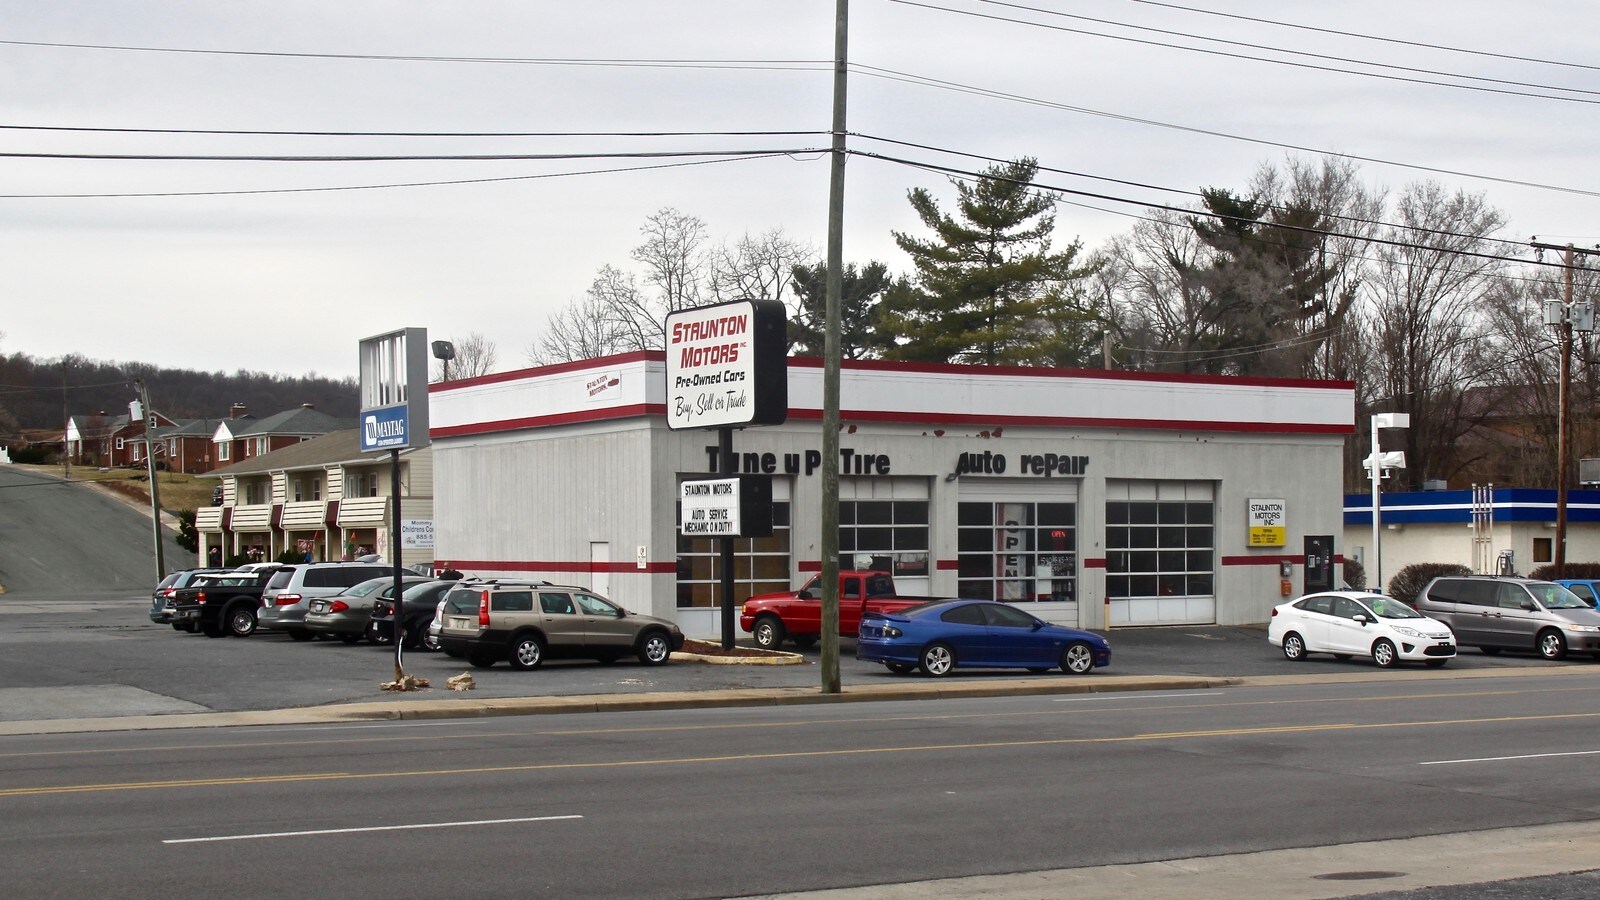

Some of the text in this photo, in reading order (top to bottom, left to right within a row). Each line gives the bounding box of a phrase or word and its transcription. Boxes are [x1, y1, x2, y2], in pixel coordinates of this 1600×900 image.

[672, 314, 748, 344] STAUNTON
[680, 342, 739, 369] MOTORS
[675, 370, 746, 388] Pre-Owned Cars
[696, 393, 714, 416] Sell
[715, 401, 724, 411] or
[726, 390, 747, 412] Trade
[377, 419, 404, 438] MAYTAG
[840, 448, 890, 474] Tire
[956, 451, 1089, 477] Auto repair
[684, 484, 732, 496] STAUNTON MOTORS
[692, 508, 728, 520] AUTO SERVICE
[684, 522, 708, 532] MECHANIC
